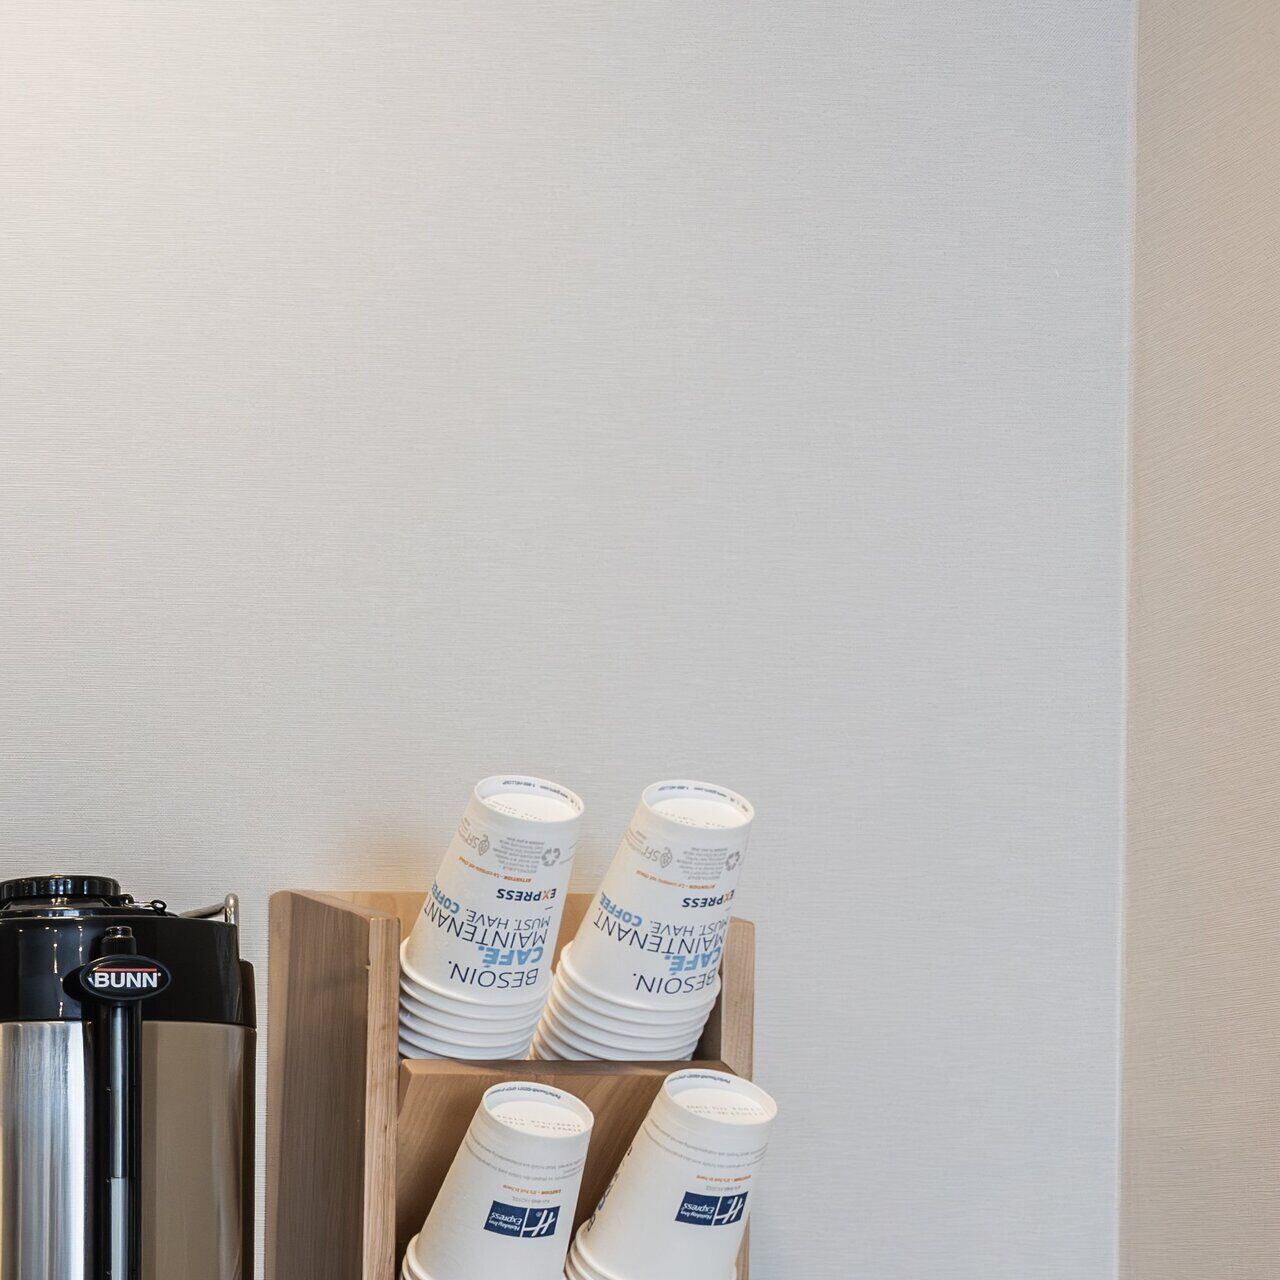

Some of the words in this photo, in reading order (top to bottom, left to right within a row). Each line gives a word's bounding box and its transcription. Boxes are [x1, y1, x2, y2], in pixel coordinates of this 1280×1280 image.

[496, 888, 557, 902] EXPRESS
[682, 889, 736, 908] EXPRESS
[466, 908, 509, 930] HAVE.
[513, 915, 551, 931] MUST.
[650, 920, 694, 937] HAVE.
[593, 907, 724, 956] MAINTENANT.
[478, 946, 544, 968] CAFÉ.
[664, 947, 721, 975] CAFÉ.
[94, 972, 158, 988] BUNN
[448, 961, 539, 989] BESOIN.
[633, 967, 717, 995] BESOIN.
[683, 1202, 715, 1214] Express
[491, 1211, 523, 1226] Express
